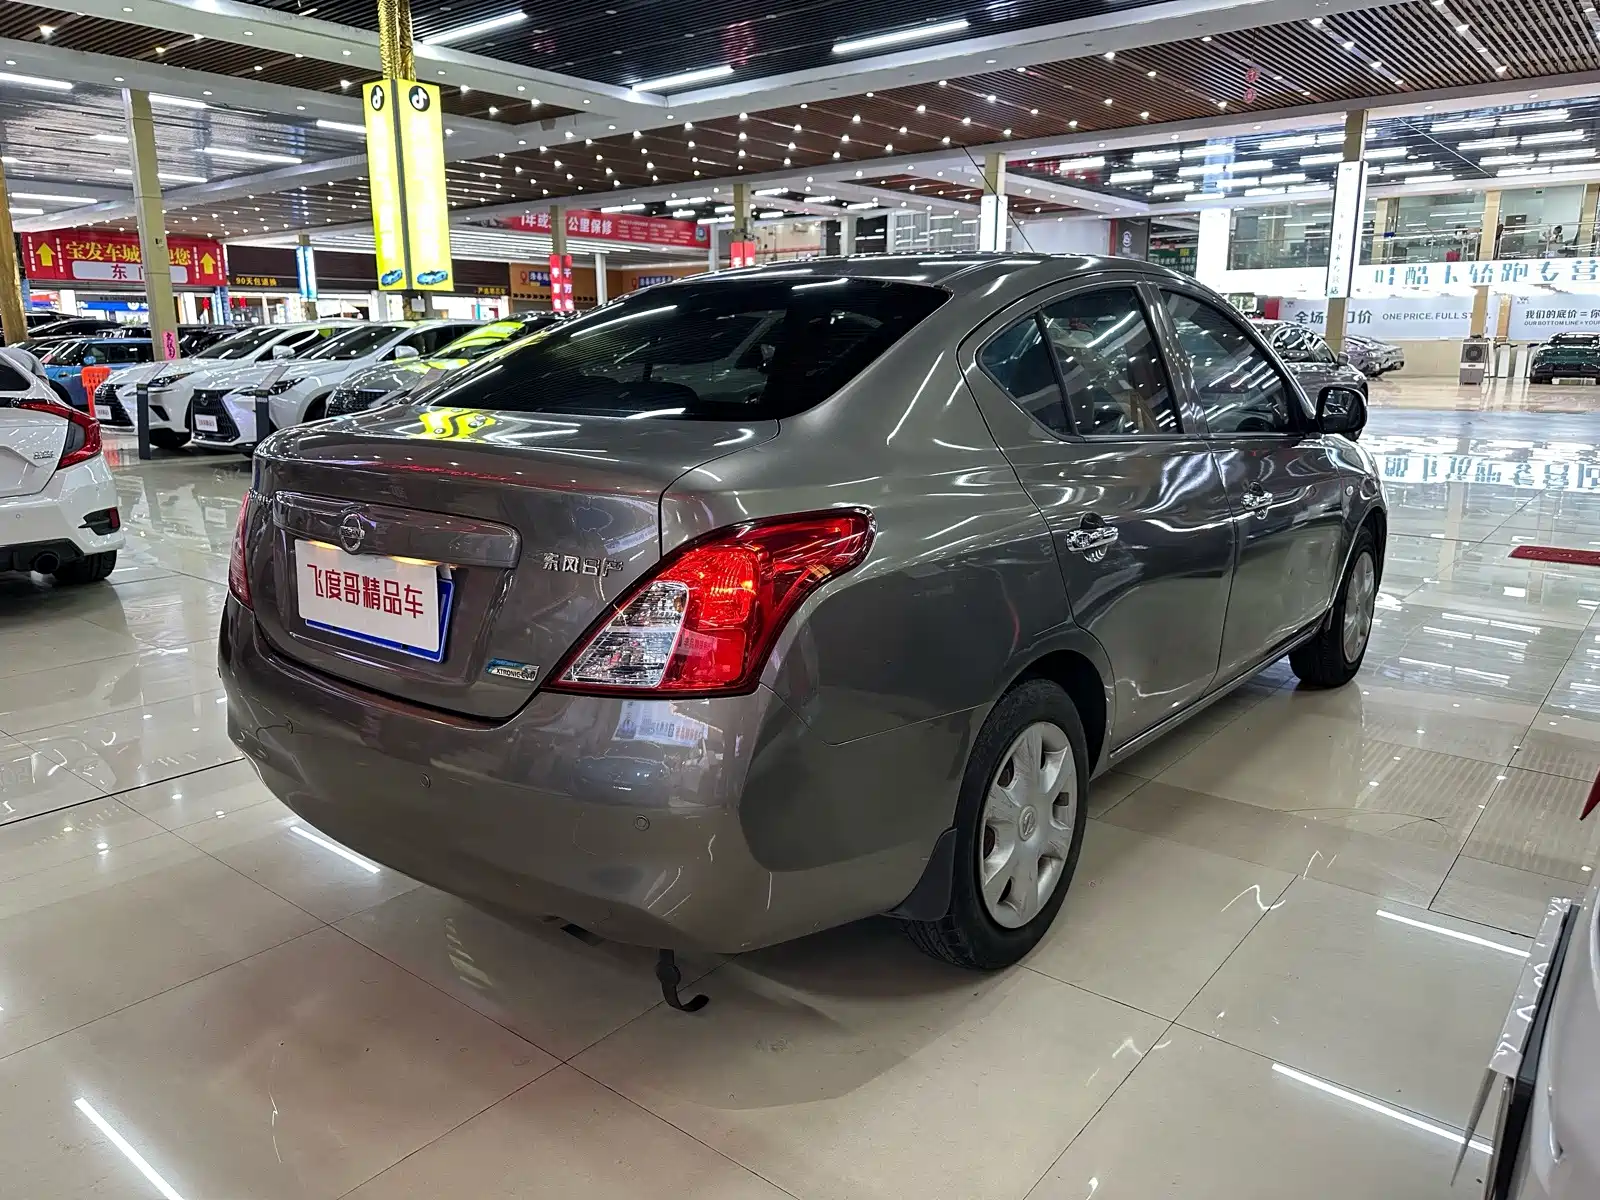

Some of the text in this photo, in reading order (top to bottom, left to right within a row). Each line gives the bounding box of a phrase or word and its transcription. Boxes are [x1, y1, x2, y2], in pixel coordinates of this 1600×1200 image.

[520, 212, 613, 236] 1年或公里保修
[65, 241, 192, 266] 宝发车城您
[1294, 310, 1373, 325] 全场口价
[1382, 312, 1402, 321] ONE
[1435, 312, 1460, 320] FULL
[543, 552, 624, 577] 东风日产
[306, 563, 425, 619] 飞度哥精品车
